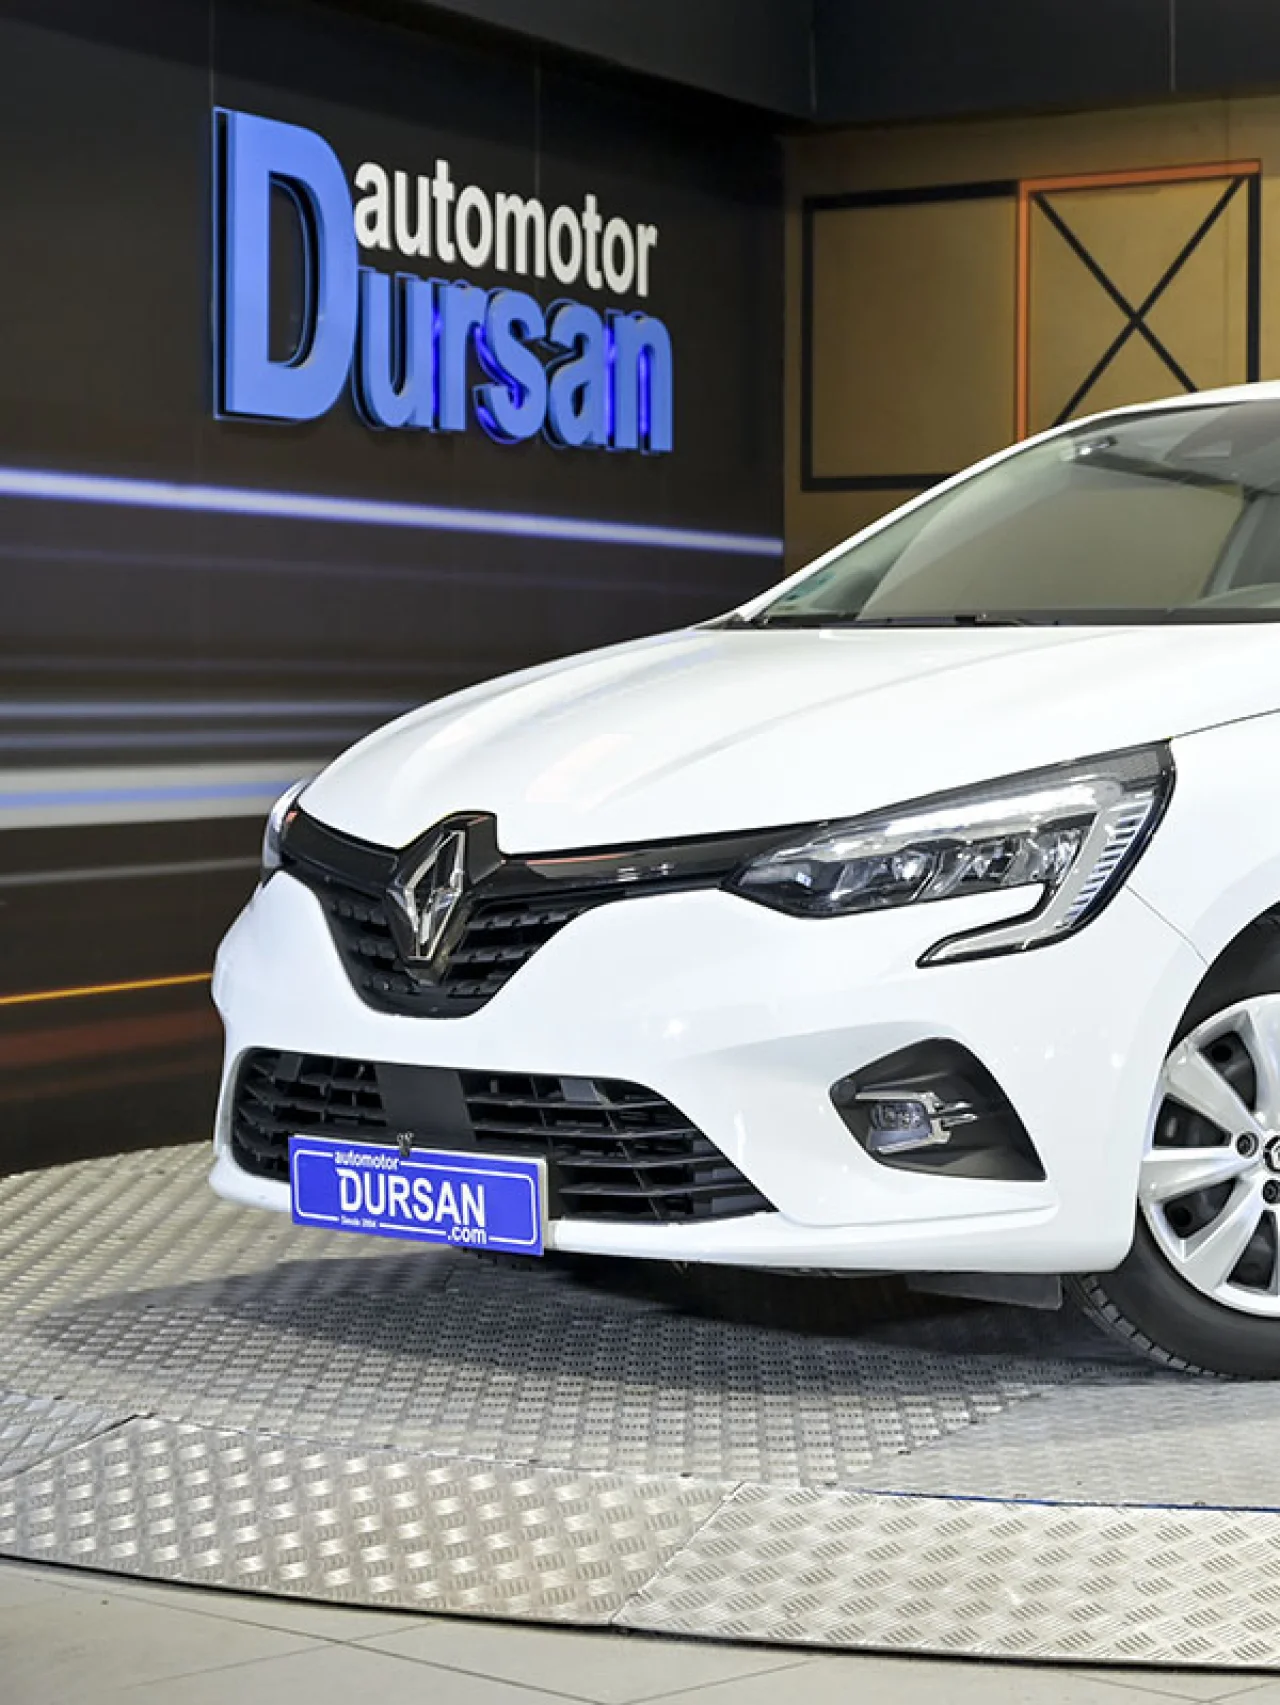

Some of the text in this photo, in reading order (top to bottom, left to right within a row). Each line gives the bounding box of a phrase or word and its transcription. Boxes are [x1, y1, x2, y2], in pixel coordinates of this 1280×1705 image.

[353, 159, 657, 296] automotor
[213, 106, 673, 452] Dursan
[335, 1150, 400, 1170] automotor
[336, 1168, 485, 1228] DURSAN
[447, 1225, 487, 1244] .com
